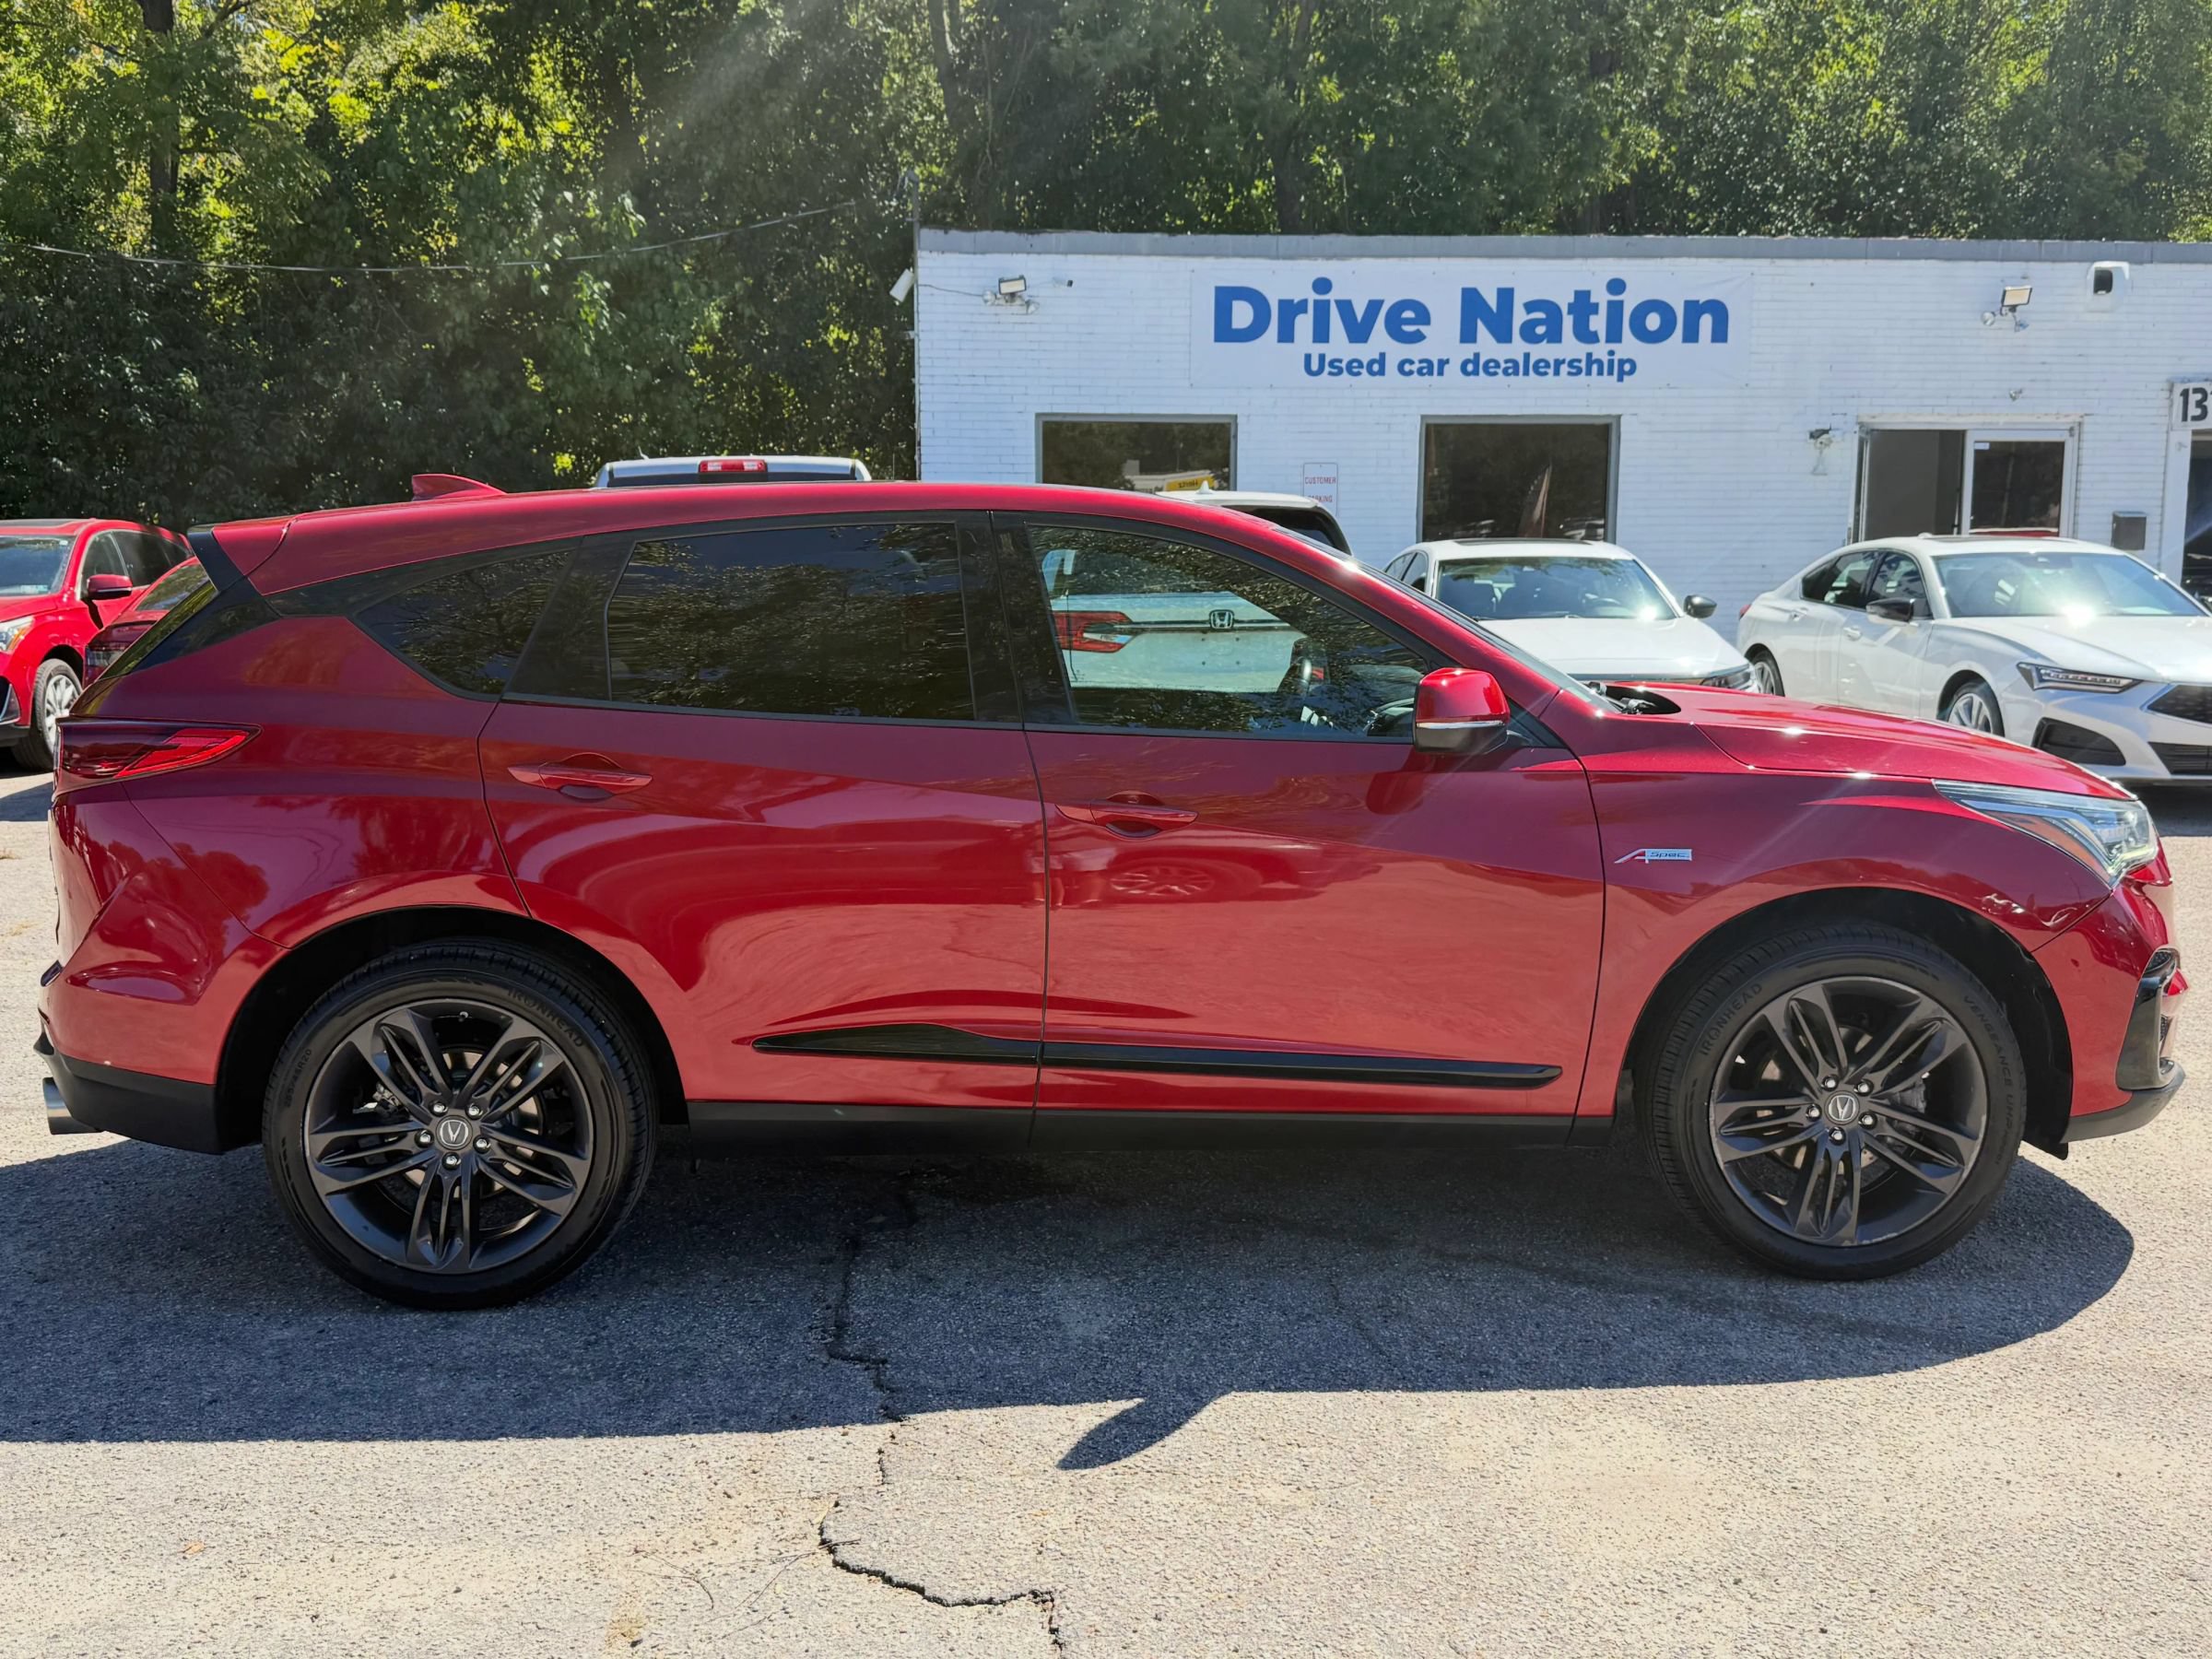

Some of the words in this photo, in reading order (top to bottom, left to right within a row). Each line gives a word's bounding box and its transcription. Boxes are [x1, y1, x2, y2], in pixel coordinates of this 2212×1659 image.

[1213, 276, 1431, 345] Drive
[1459, 277, 1730, 345] Nation
[1303, 352, 1386, 377] Used
[1396, 357, 1450, 377] car
[1460, 349, 1638, 382] dealership
[2180, 387, 2212, 422] 13
[1304, 477, 1336, 485] CUSTOMER
[1699, 982, 1762, 1055] IRONHEAD
[1964, 994, 2014, 1087] VENGEANCE
